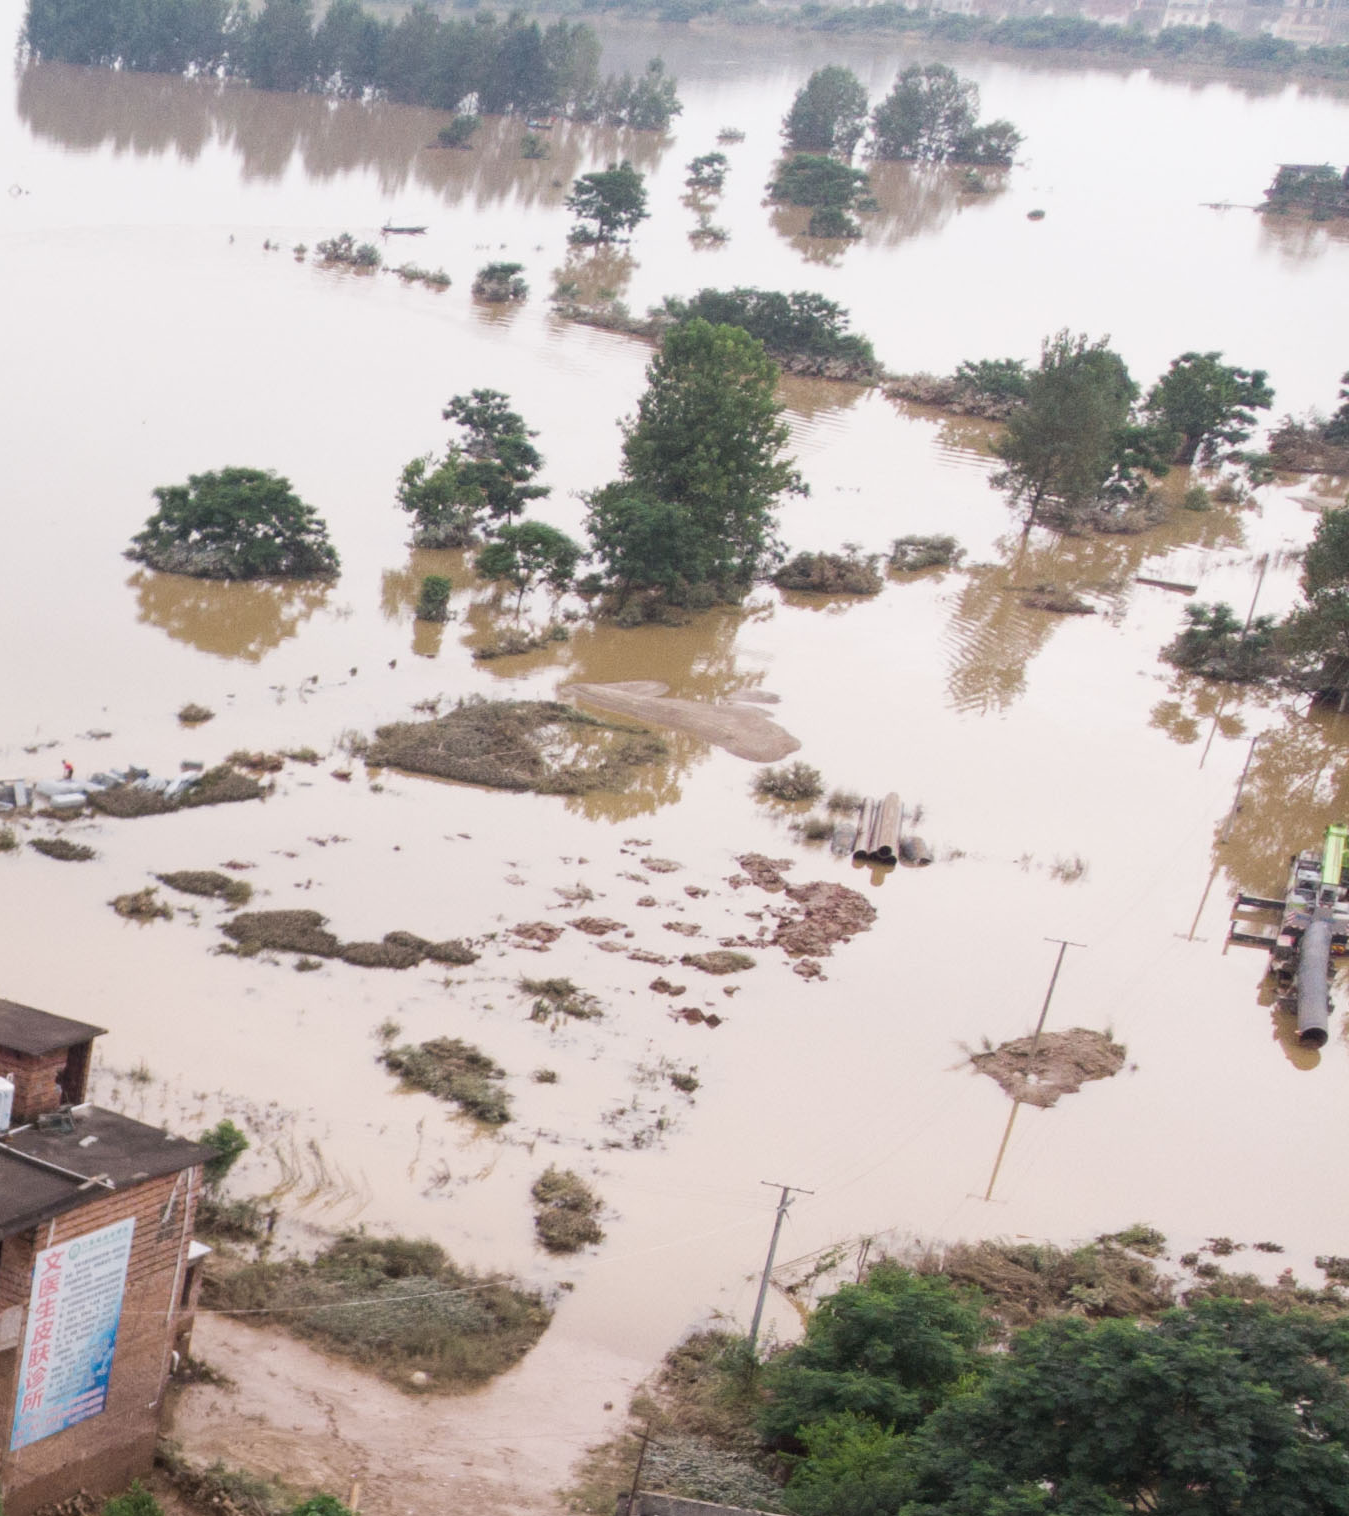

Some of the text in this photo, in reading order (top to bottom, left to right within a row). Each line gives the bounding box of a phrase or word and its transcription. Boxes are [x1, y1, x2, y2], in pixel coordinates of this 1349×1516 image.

[21, 1250, 66, 1415] 文医生皮肤诊所
